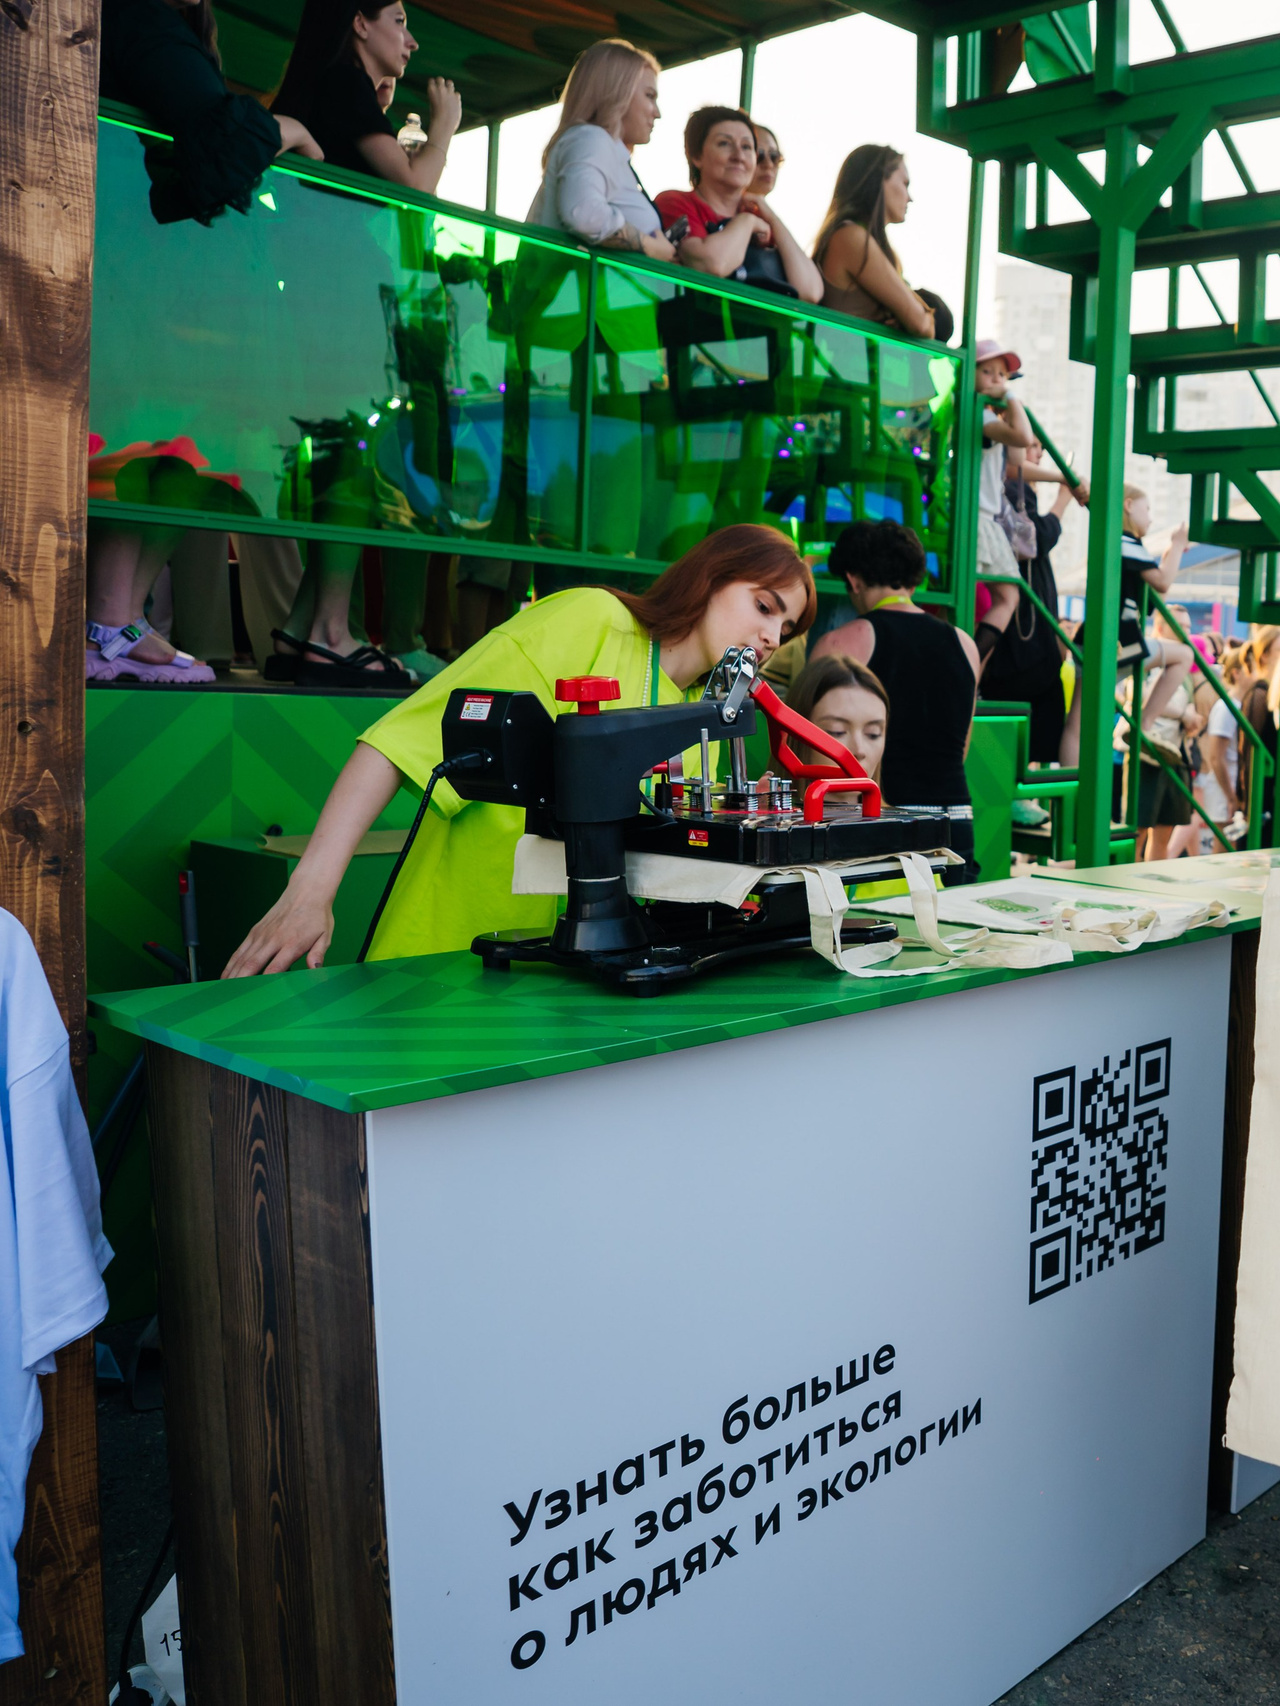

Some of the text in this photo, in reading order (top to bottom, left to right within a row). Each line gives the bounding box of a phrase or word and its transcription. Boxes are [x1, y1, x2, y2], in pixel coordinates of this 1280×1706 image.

[502, 1343, 896, 1547] Узнать больше
[508, 1389, 902, 1612] как заботиться
[510, 1397, 982, 1670] о людях и экологии
